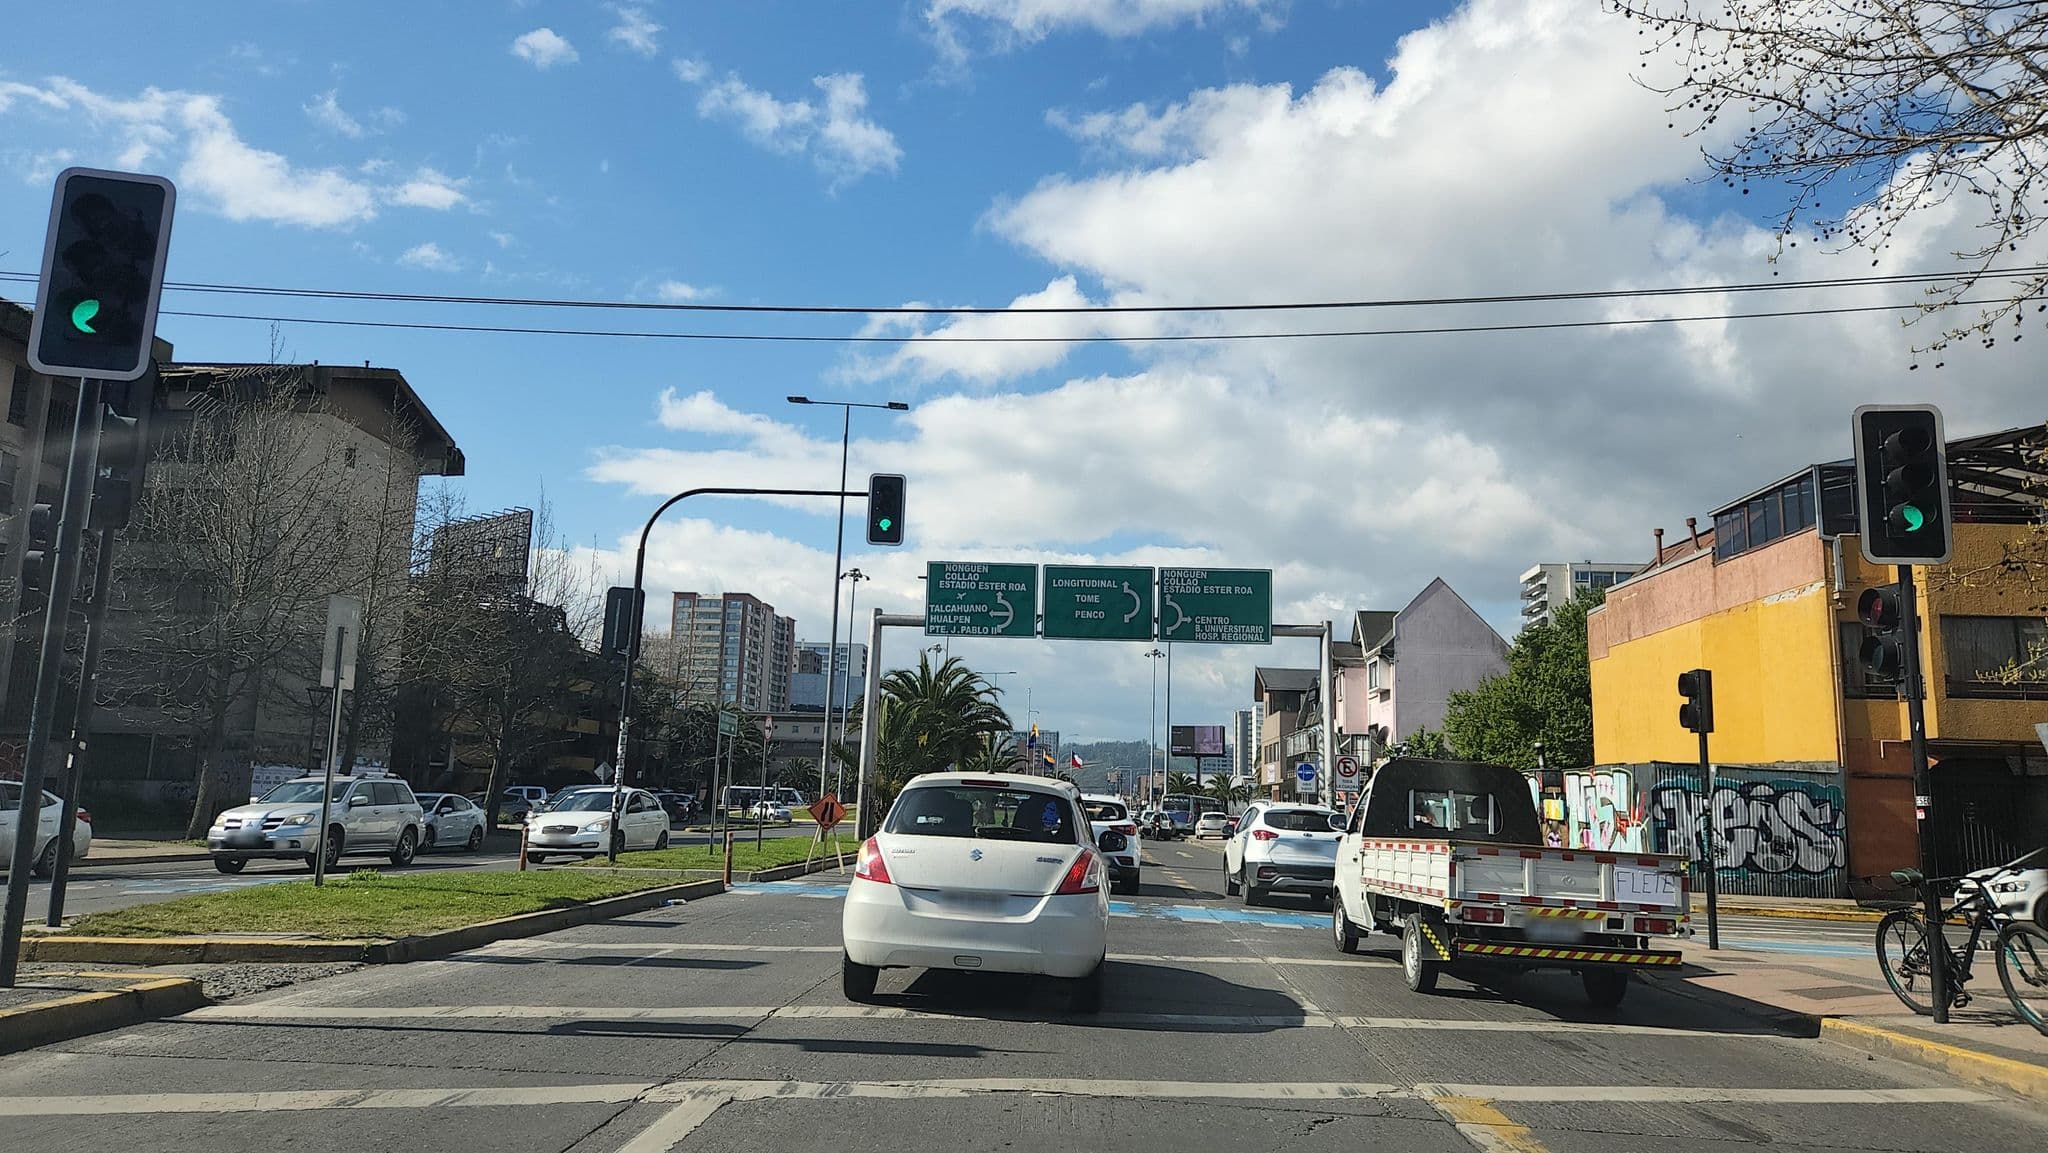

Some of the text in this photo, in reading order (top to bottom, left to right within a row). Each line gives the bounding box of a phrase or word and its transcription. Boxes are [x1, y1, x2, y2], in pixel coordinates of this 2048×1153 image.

[945, 564, 988, 573] NONGUEN
[1164, 570, 1207, 579] NONGUEN
[939, 581, 1026, 591] ESTADIO ESTER ROA
[1053, 579, 1118, 588] LONGITUDINAL
[1075, 594, 1100, 602] TOME
[930, 615, 970, 623] HUALPEN
[1075, 611, 1105, 619] PENCO
[1205, 625, 1264, 633] UNIVERSITARIO
